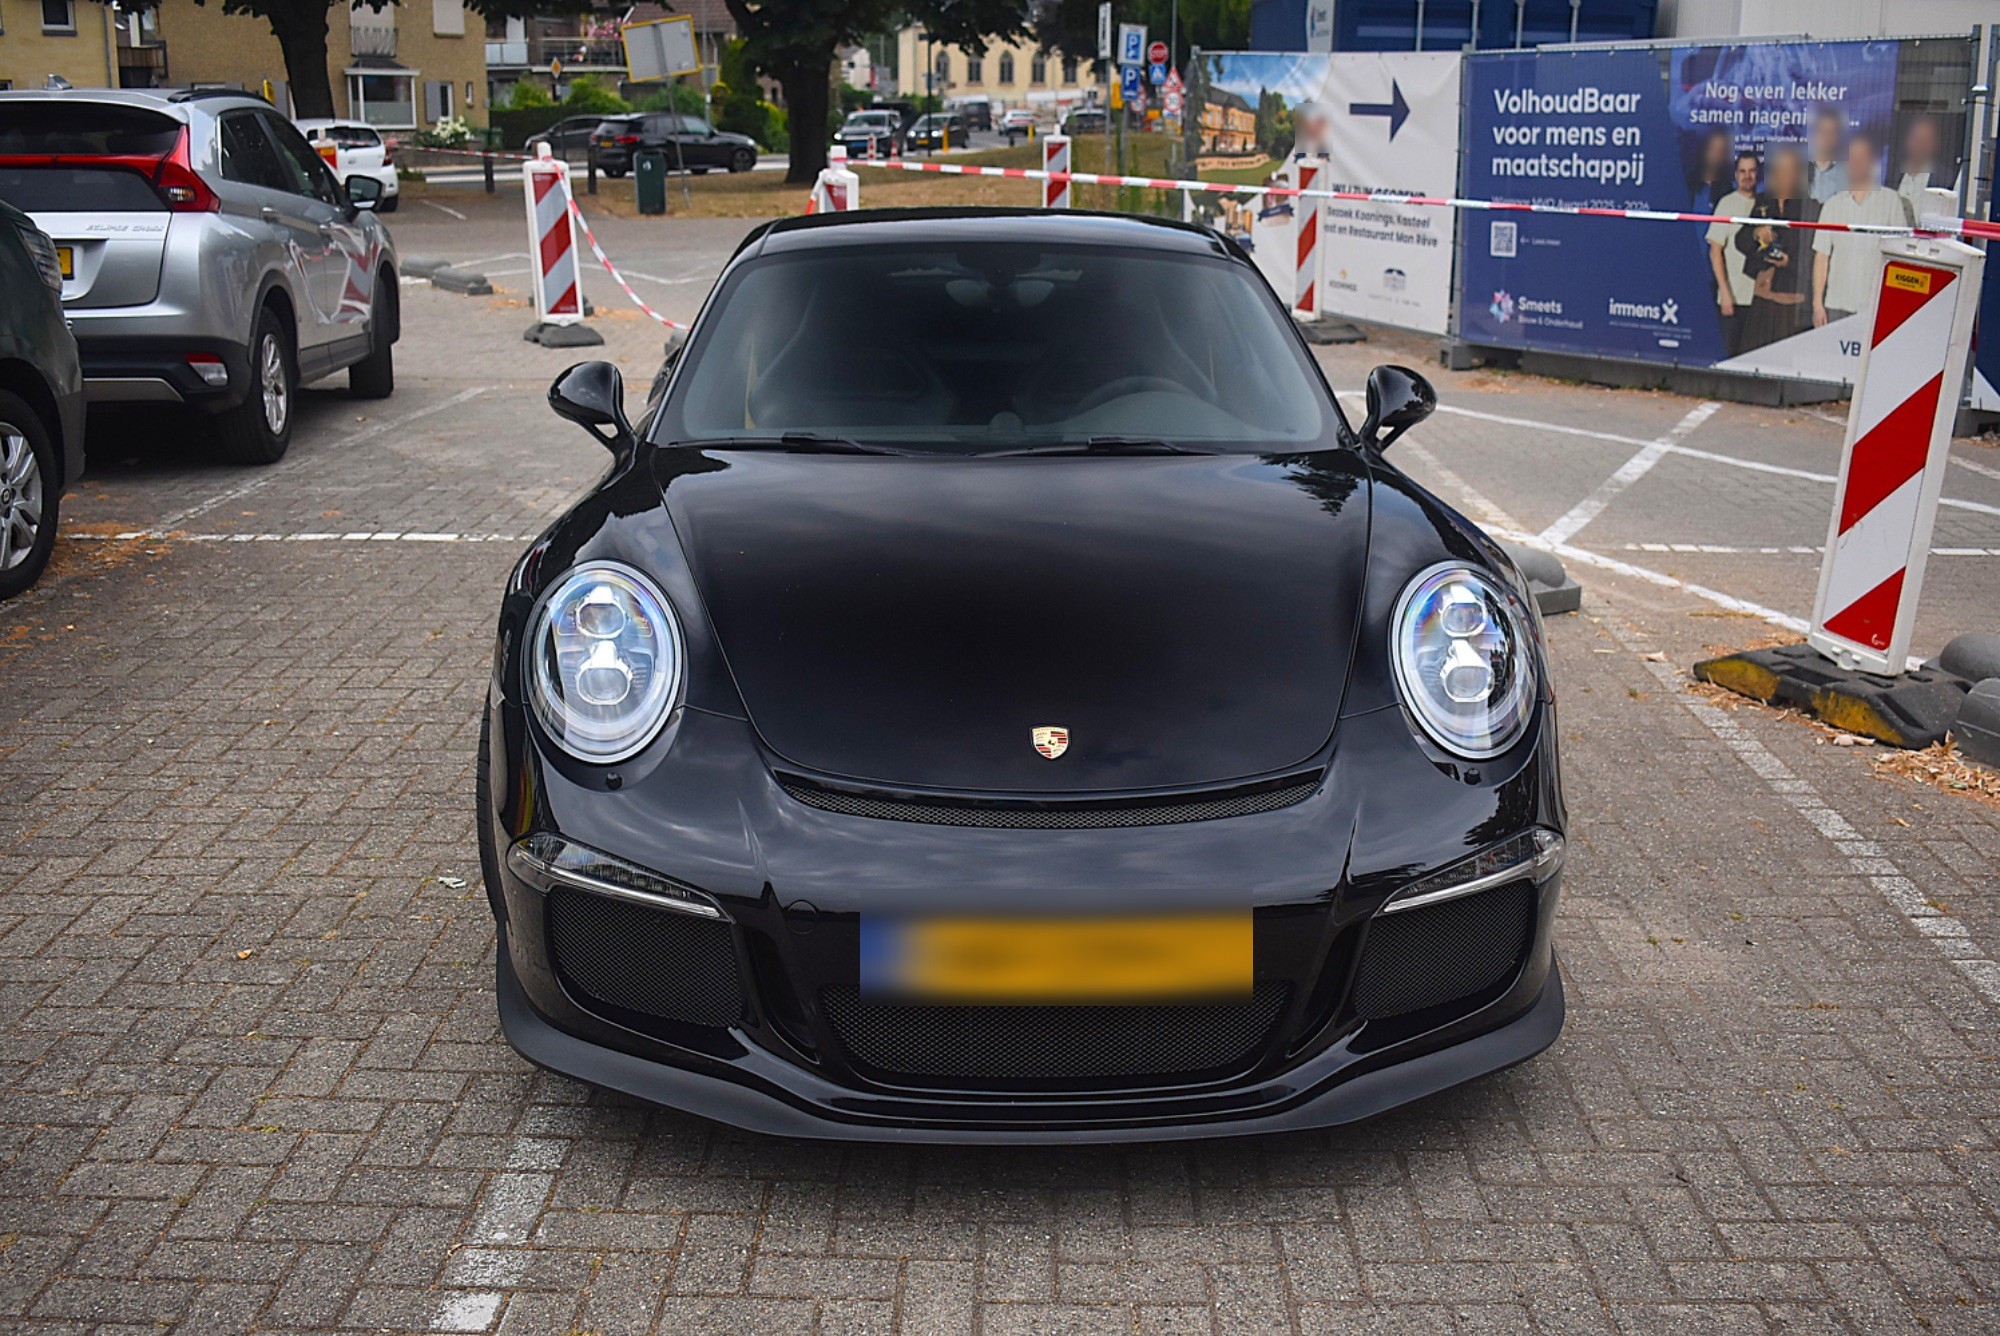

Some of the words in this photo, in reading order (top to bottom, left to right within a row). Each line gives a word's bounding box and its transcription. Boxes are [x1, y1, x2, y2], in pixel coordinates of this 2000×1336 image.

[1125, 69, 1136, 87] P
[1493, 87, 1641, 114] VolhoudBaar
[1705, 82, 1738, 102] Nog
[1744, 85, 1784, 100] even
[1791, 82, 1847, 100] lekker
[1690, 108, 1743, 123] samen
[1492, 125, 1541, 145] voor
[1545, 126, 1607, 147] mens
[1611, 126, 1641, 147] en
[1491, 152, 1645, 186] maatschappij
[1397, 214, 1431, 229] Kasteel
[1338, 225, 1347, 234] en
[1349, 226, 1394, 241] Restaurant
[1396, 231, 1414, 244] Mon
[1895, 273, 1919, 284] KIGGEN
[1518, 295, 1562, 314] Smeets
